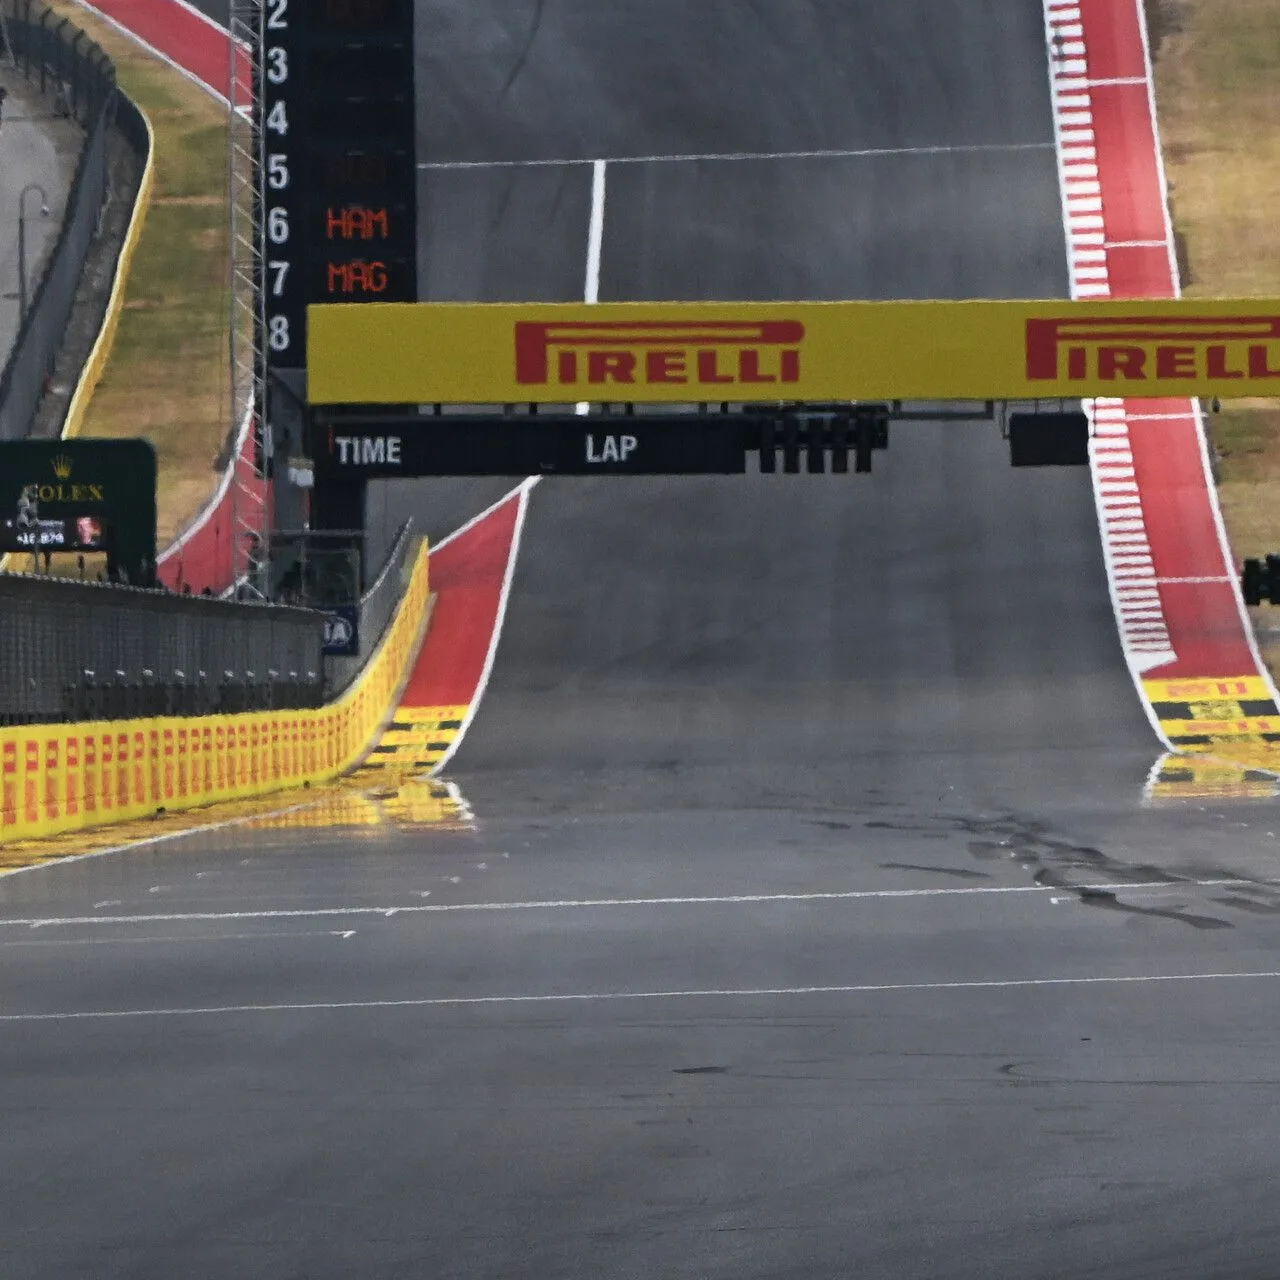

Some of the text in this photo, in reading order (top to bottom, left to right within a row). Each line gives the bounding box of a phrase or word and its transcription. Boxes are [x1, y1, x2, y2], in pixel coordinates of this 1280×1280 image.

[267, 48, 288, 83] 3
[267, 102, 289, 135] 4
[268, 155, 289, 190] 5
[268, 208, 388, 243] 6 HAM
[268, 261, 388, 295] 7 MAG
[269, 316, 290, 350] 8
[515, 321, 805, 384] PIRELLI
[335, 436, 402, 464] TIME
[586, 435, 638, 464] LAP
